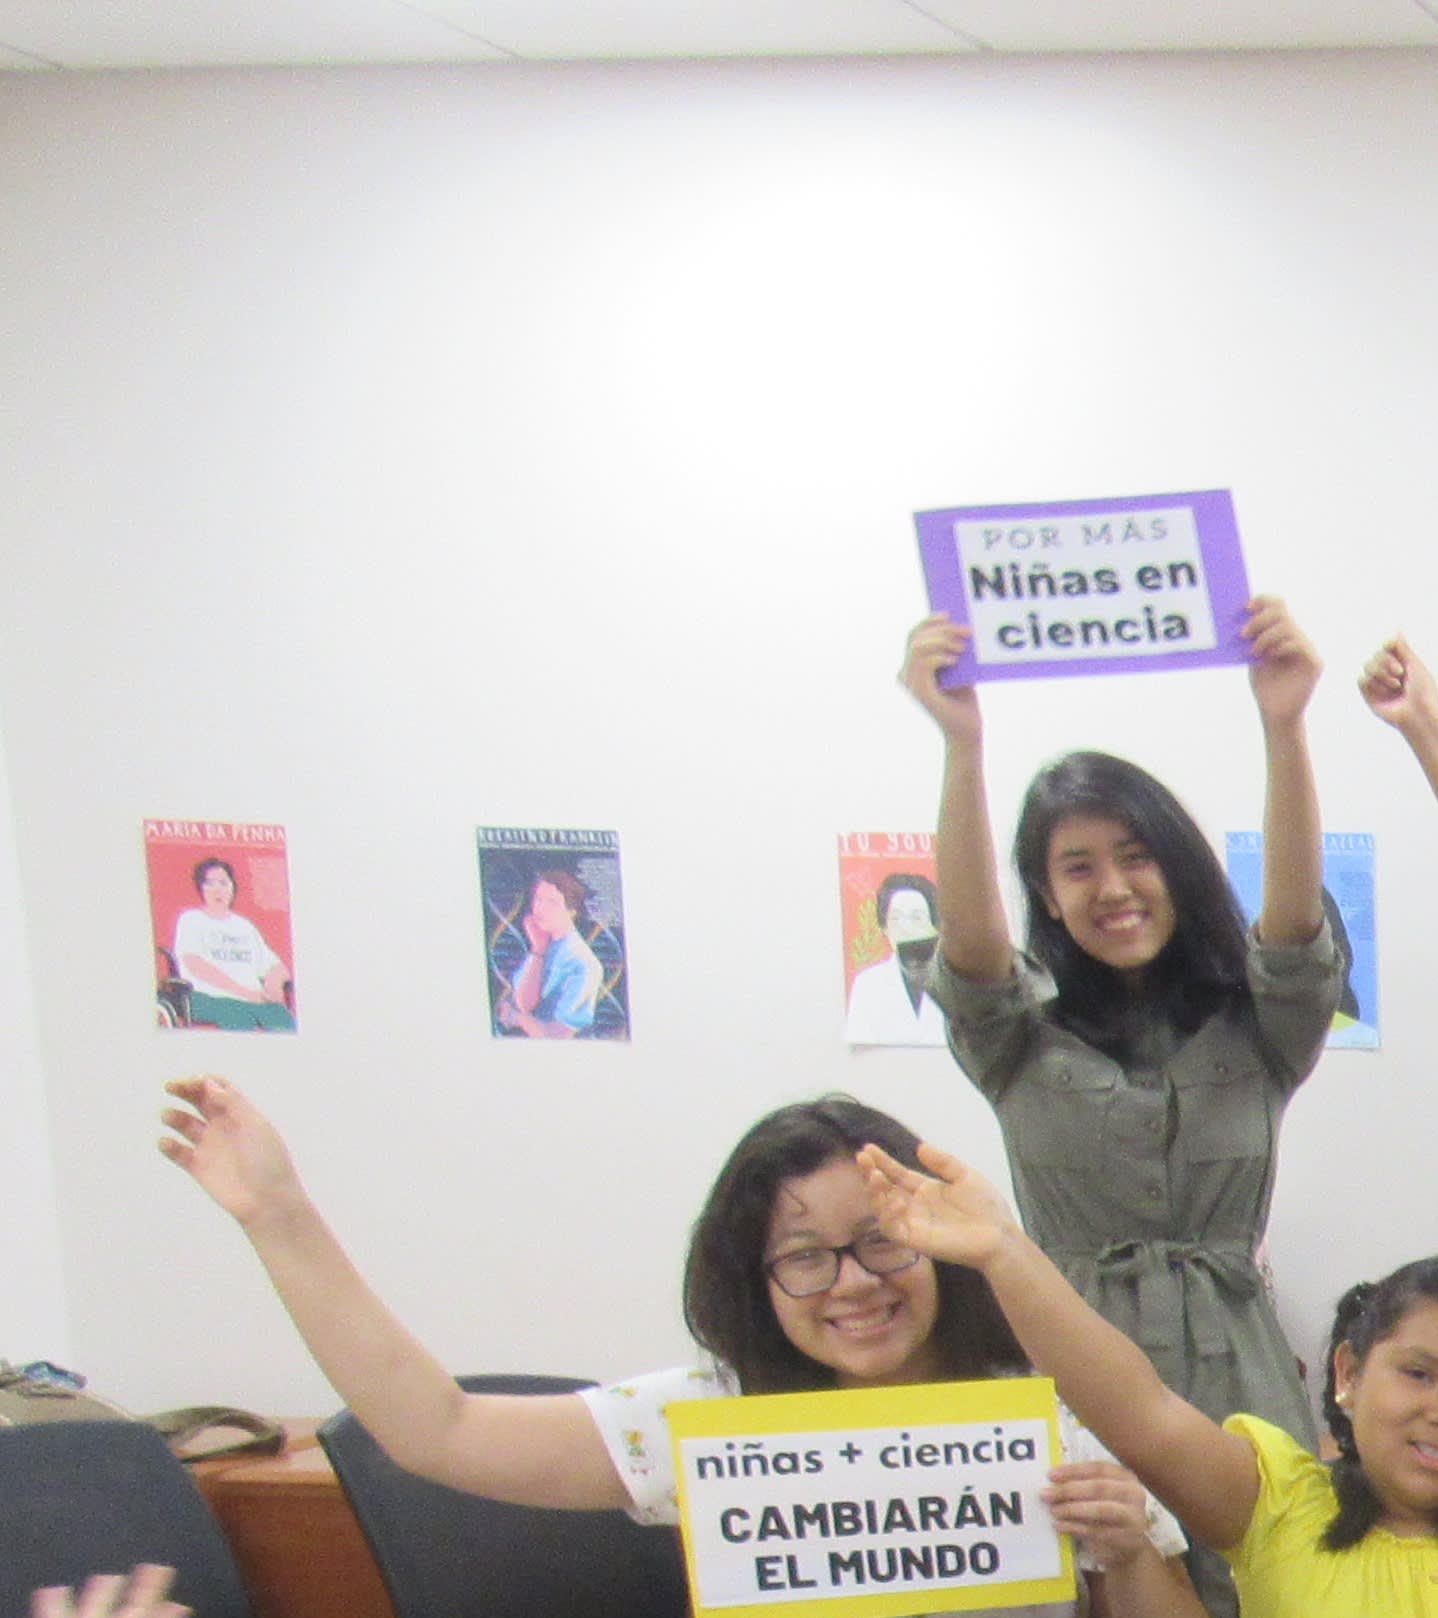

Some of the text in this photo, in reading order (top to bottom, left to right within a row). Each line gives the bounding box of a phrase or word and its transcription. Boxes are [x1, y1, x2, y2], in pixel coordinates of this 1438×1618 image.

[982, 515, 1170, 552] POR MÁS
[969, 558, 1199, 601] Niñas en
[998, 605, 1191, 651] ciencia
[697, 1427, 1036, 1480] niñas + ciencia
[719, 1485, 1025, 1545] CAMBIARÁN
[754, 1541, 1001, 1592] EL MUNDO
